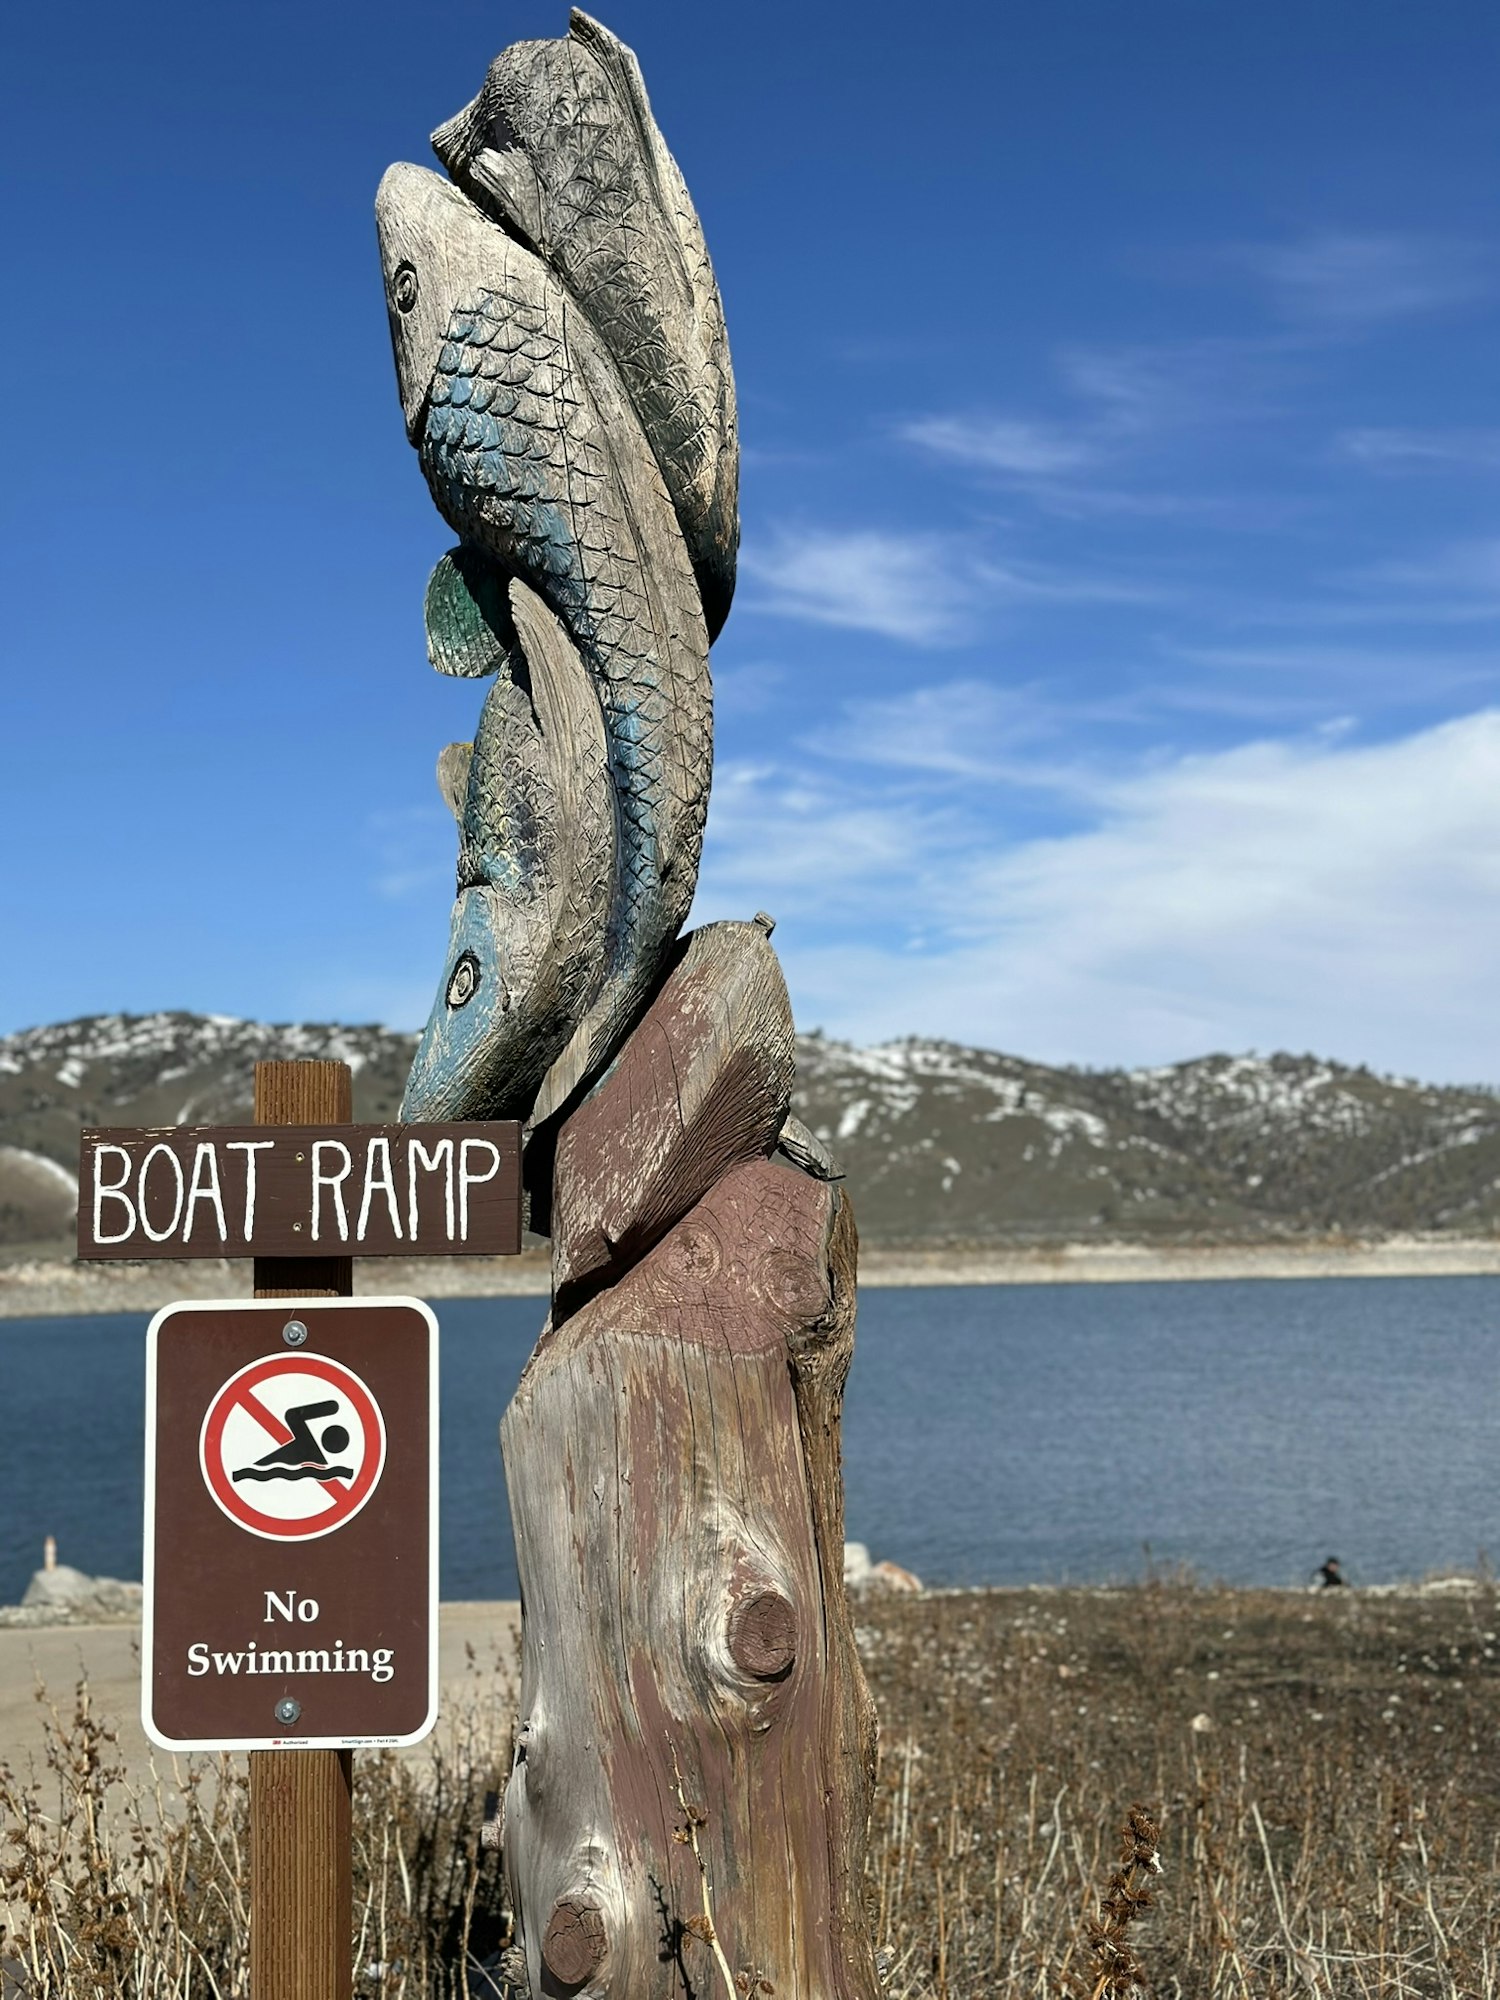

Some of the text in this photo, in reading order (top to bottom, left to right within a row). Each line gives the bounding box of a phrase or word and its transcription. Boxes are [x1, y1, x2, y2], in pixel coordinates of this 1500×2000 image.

[93, 1137, 500, 1244] BOAT RAMP
[263, 1590, 320, 1623] No
[187, 1639, 395, 1683] Swimming
